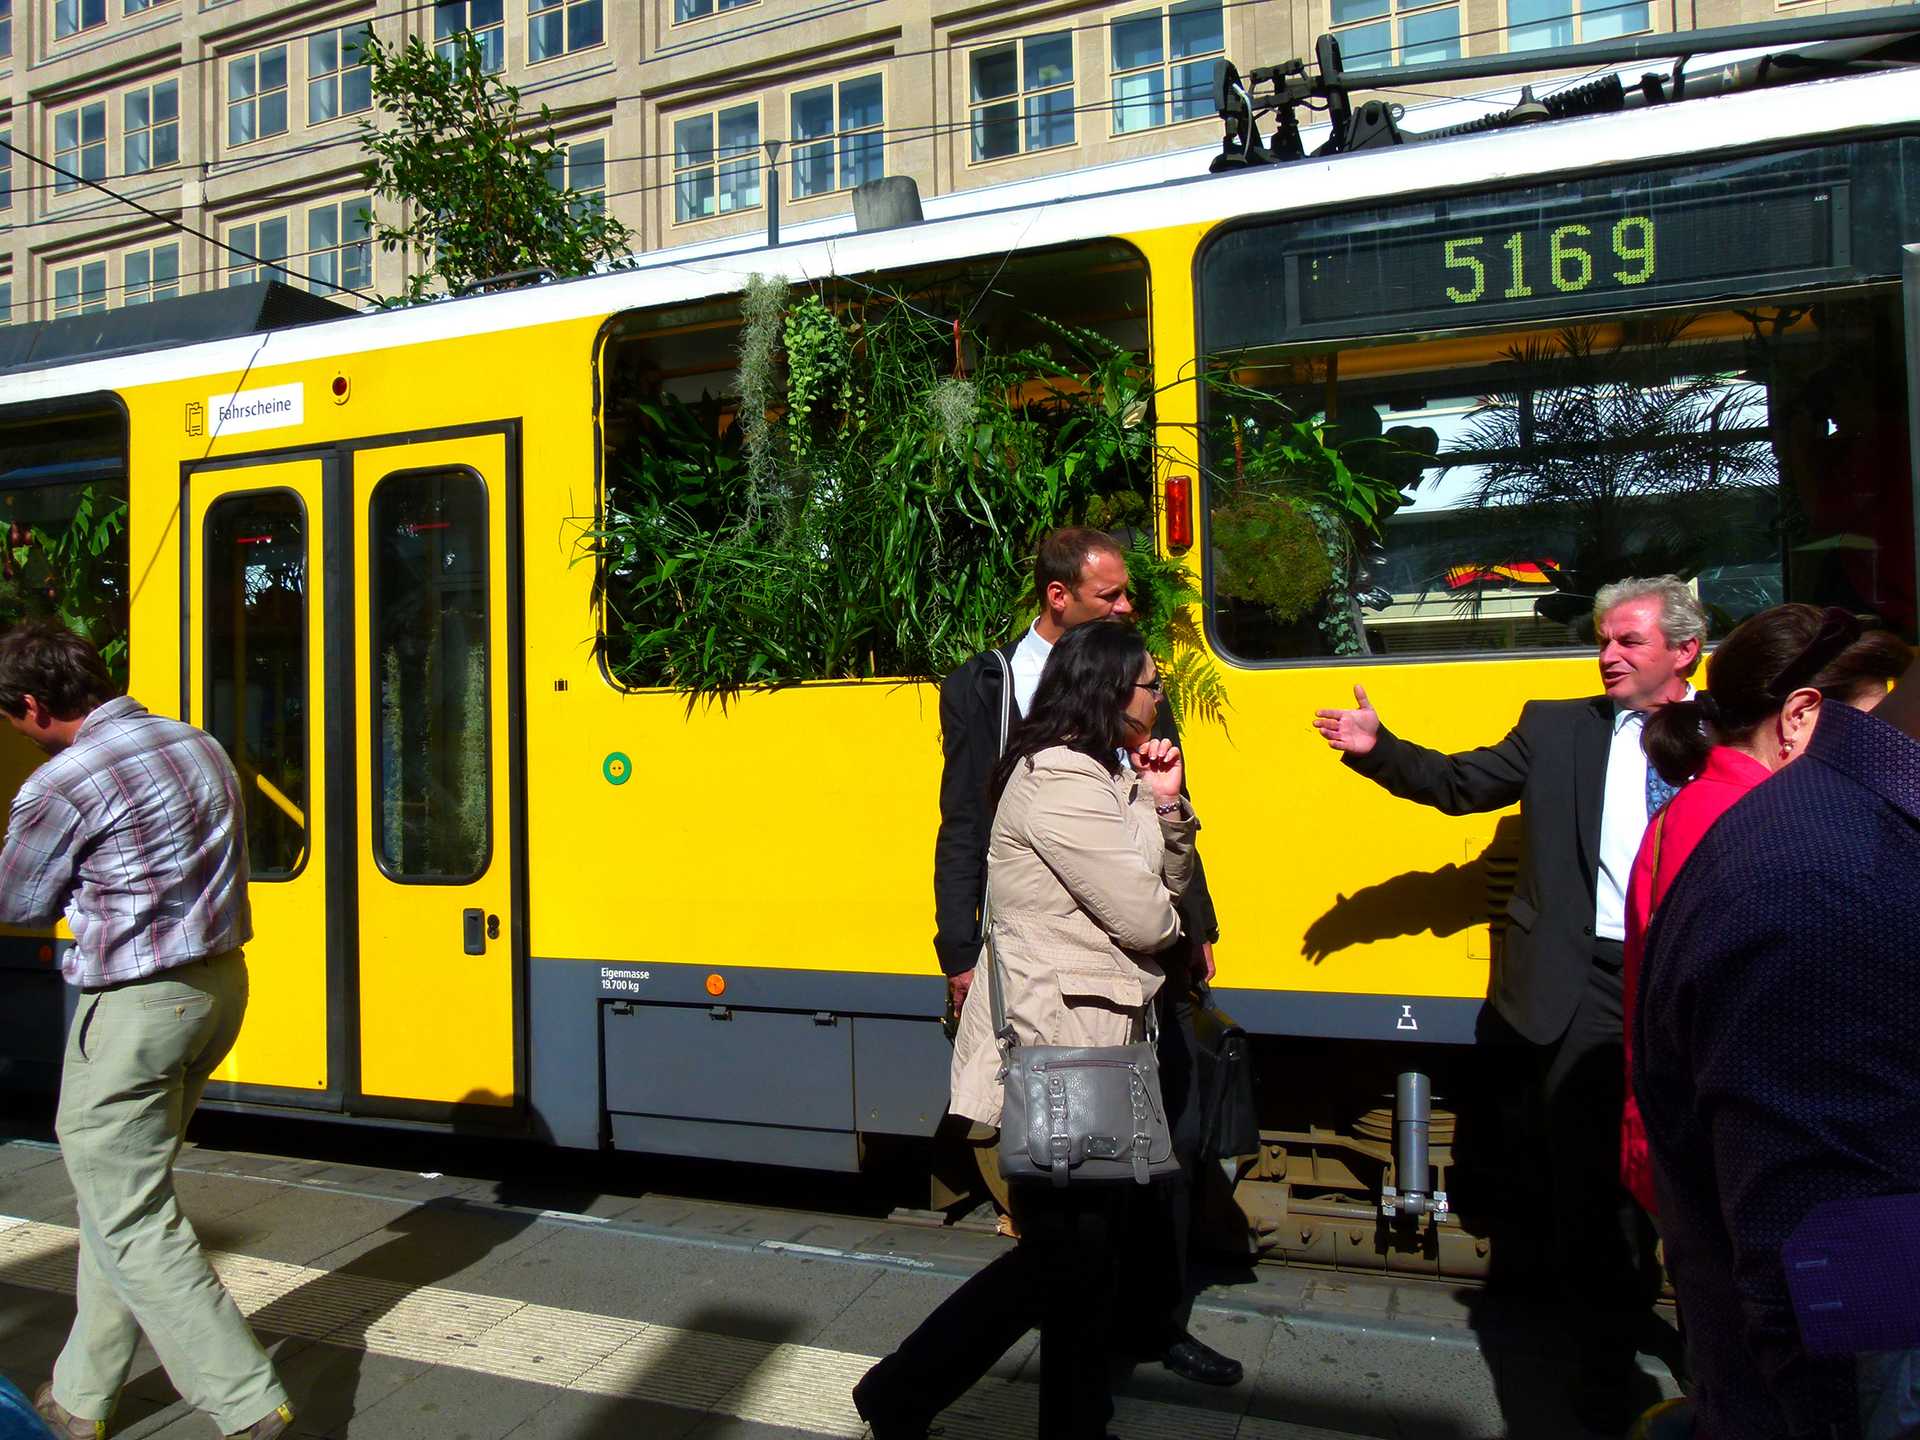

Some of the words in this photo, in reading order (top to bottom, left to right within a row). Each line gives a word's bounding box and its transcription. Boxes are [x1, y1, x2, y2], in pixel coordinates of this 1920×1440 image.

[1444, 215, 1656, 304] 5169
[218, 397, 292, 422] Fahrscheine
[601, 967, 650, 980] Eigenmasse
[601, 979, 627, 990] 19.700
[628, 981, 640, 993] kg
